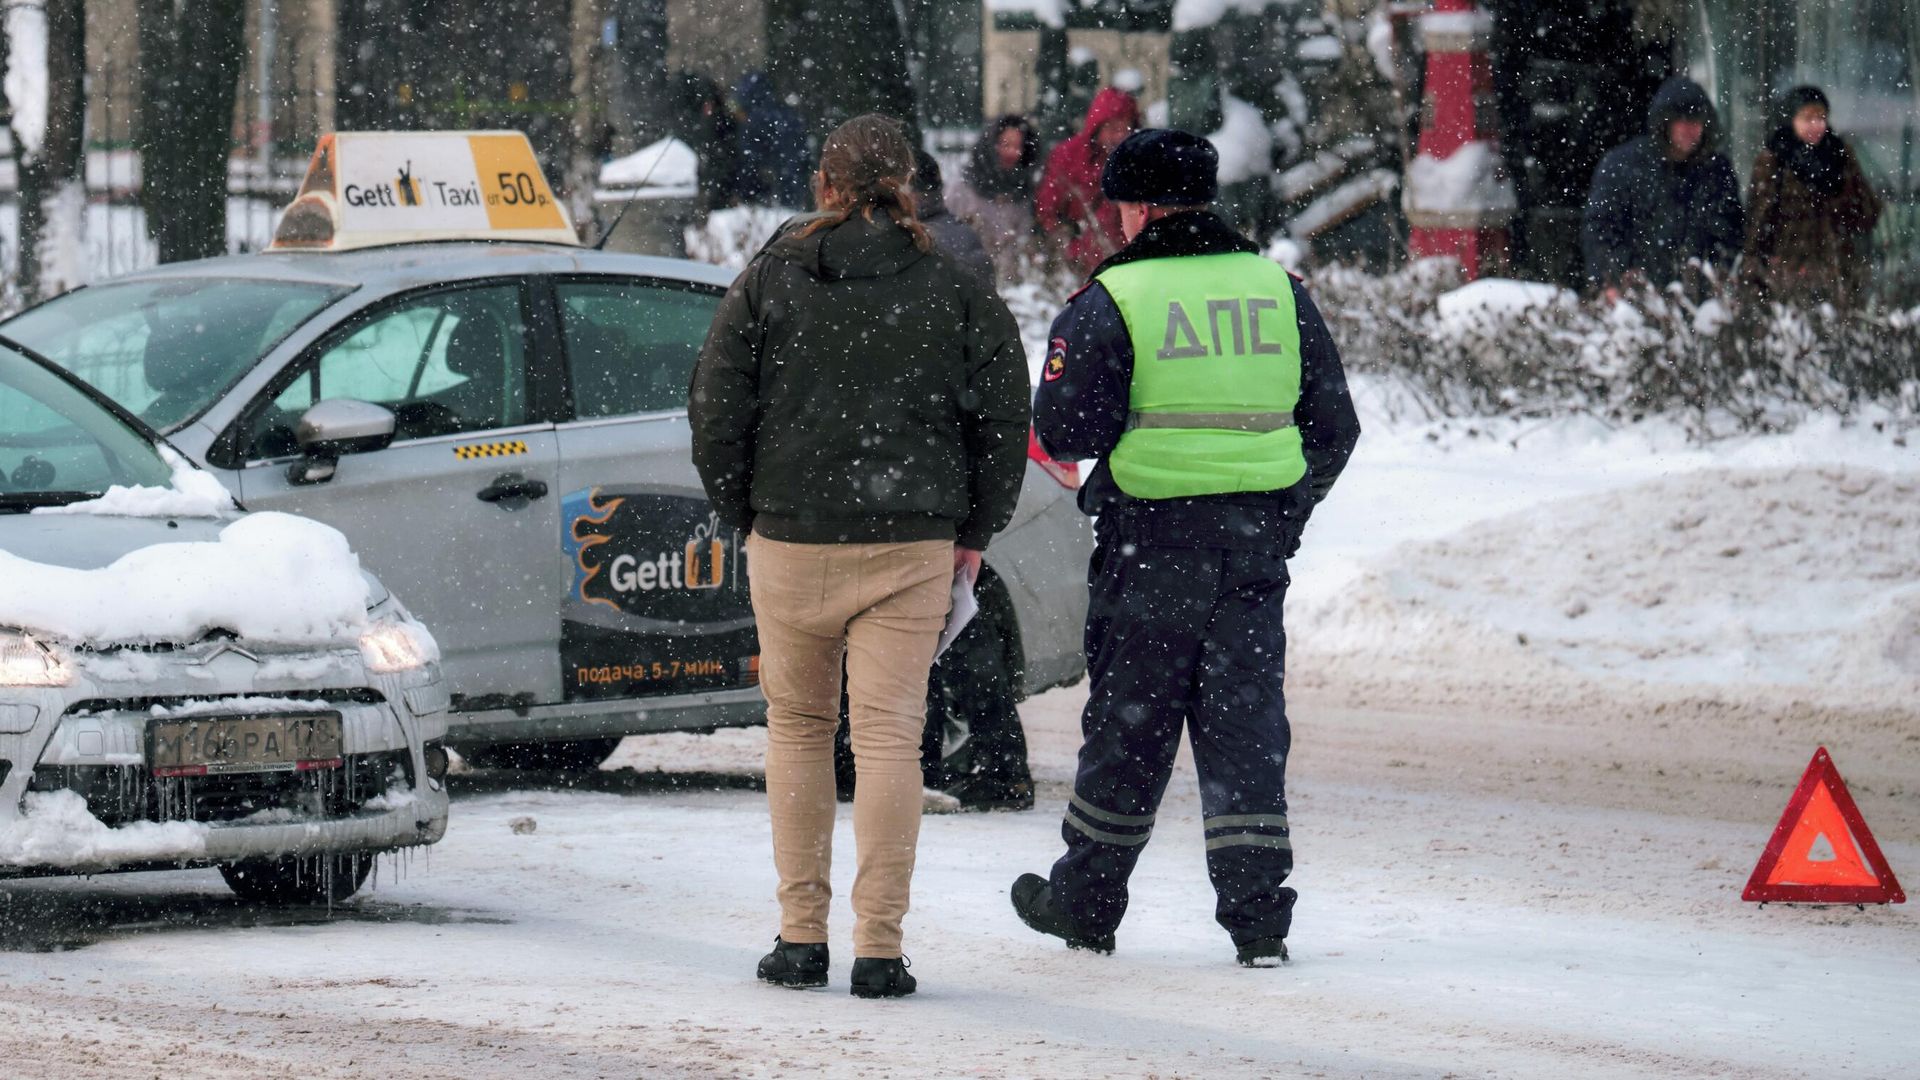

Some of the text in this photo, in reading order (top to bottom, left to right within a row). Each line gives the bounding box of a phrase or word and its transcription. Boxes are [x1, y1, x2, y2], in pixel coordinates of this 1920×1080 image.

[345, 181, 479, 207] Gett Taxi
[1156, 299, 1282, 360] ДПС
[610, 552, 682, 592] Gett
[652, 662, 679, 679] 5-7
